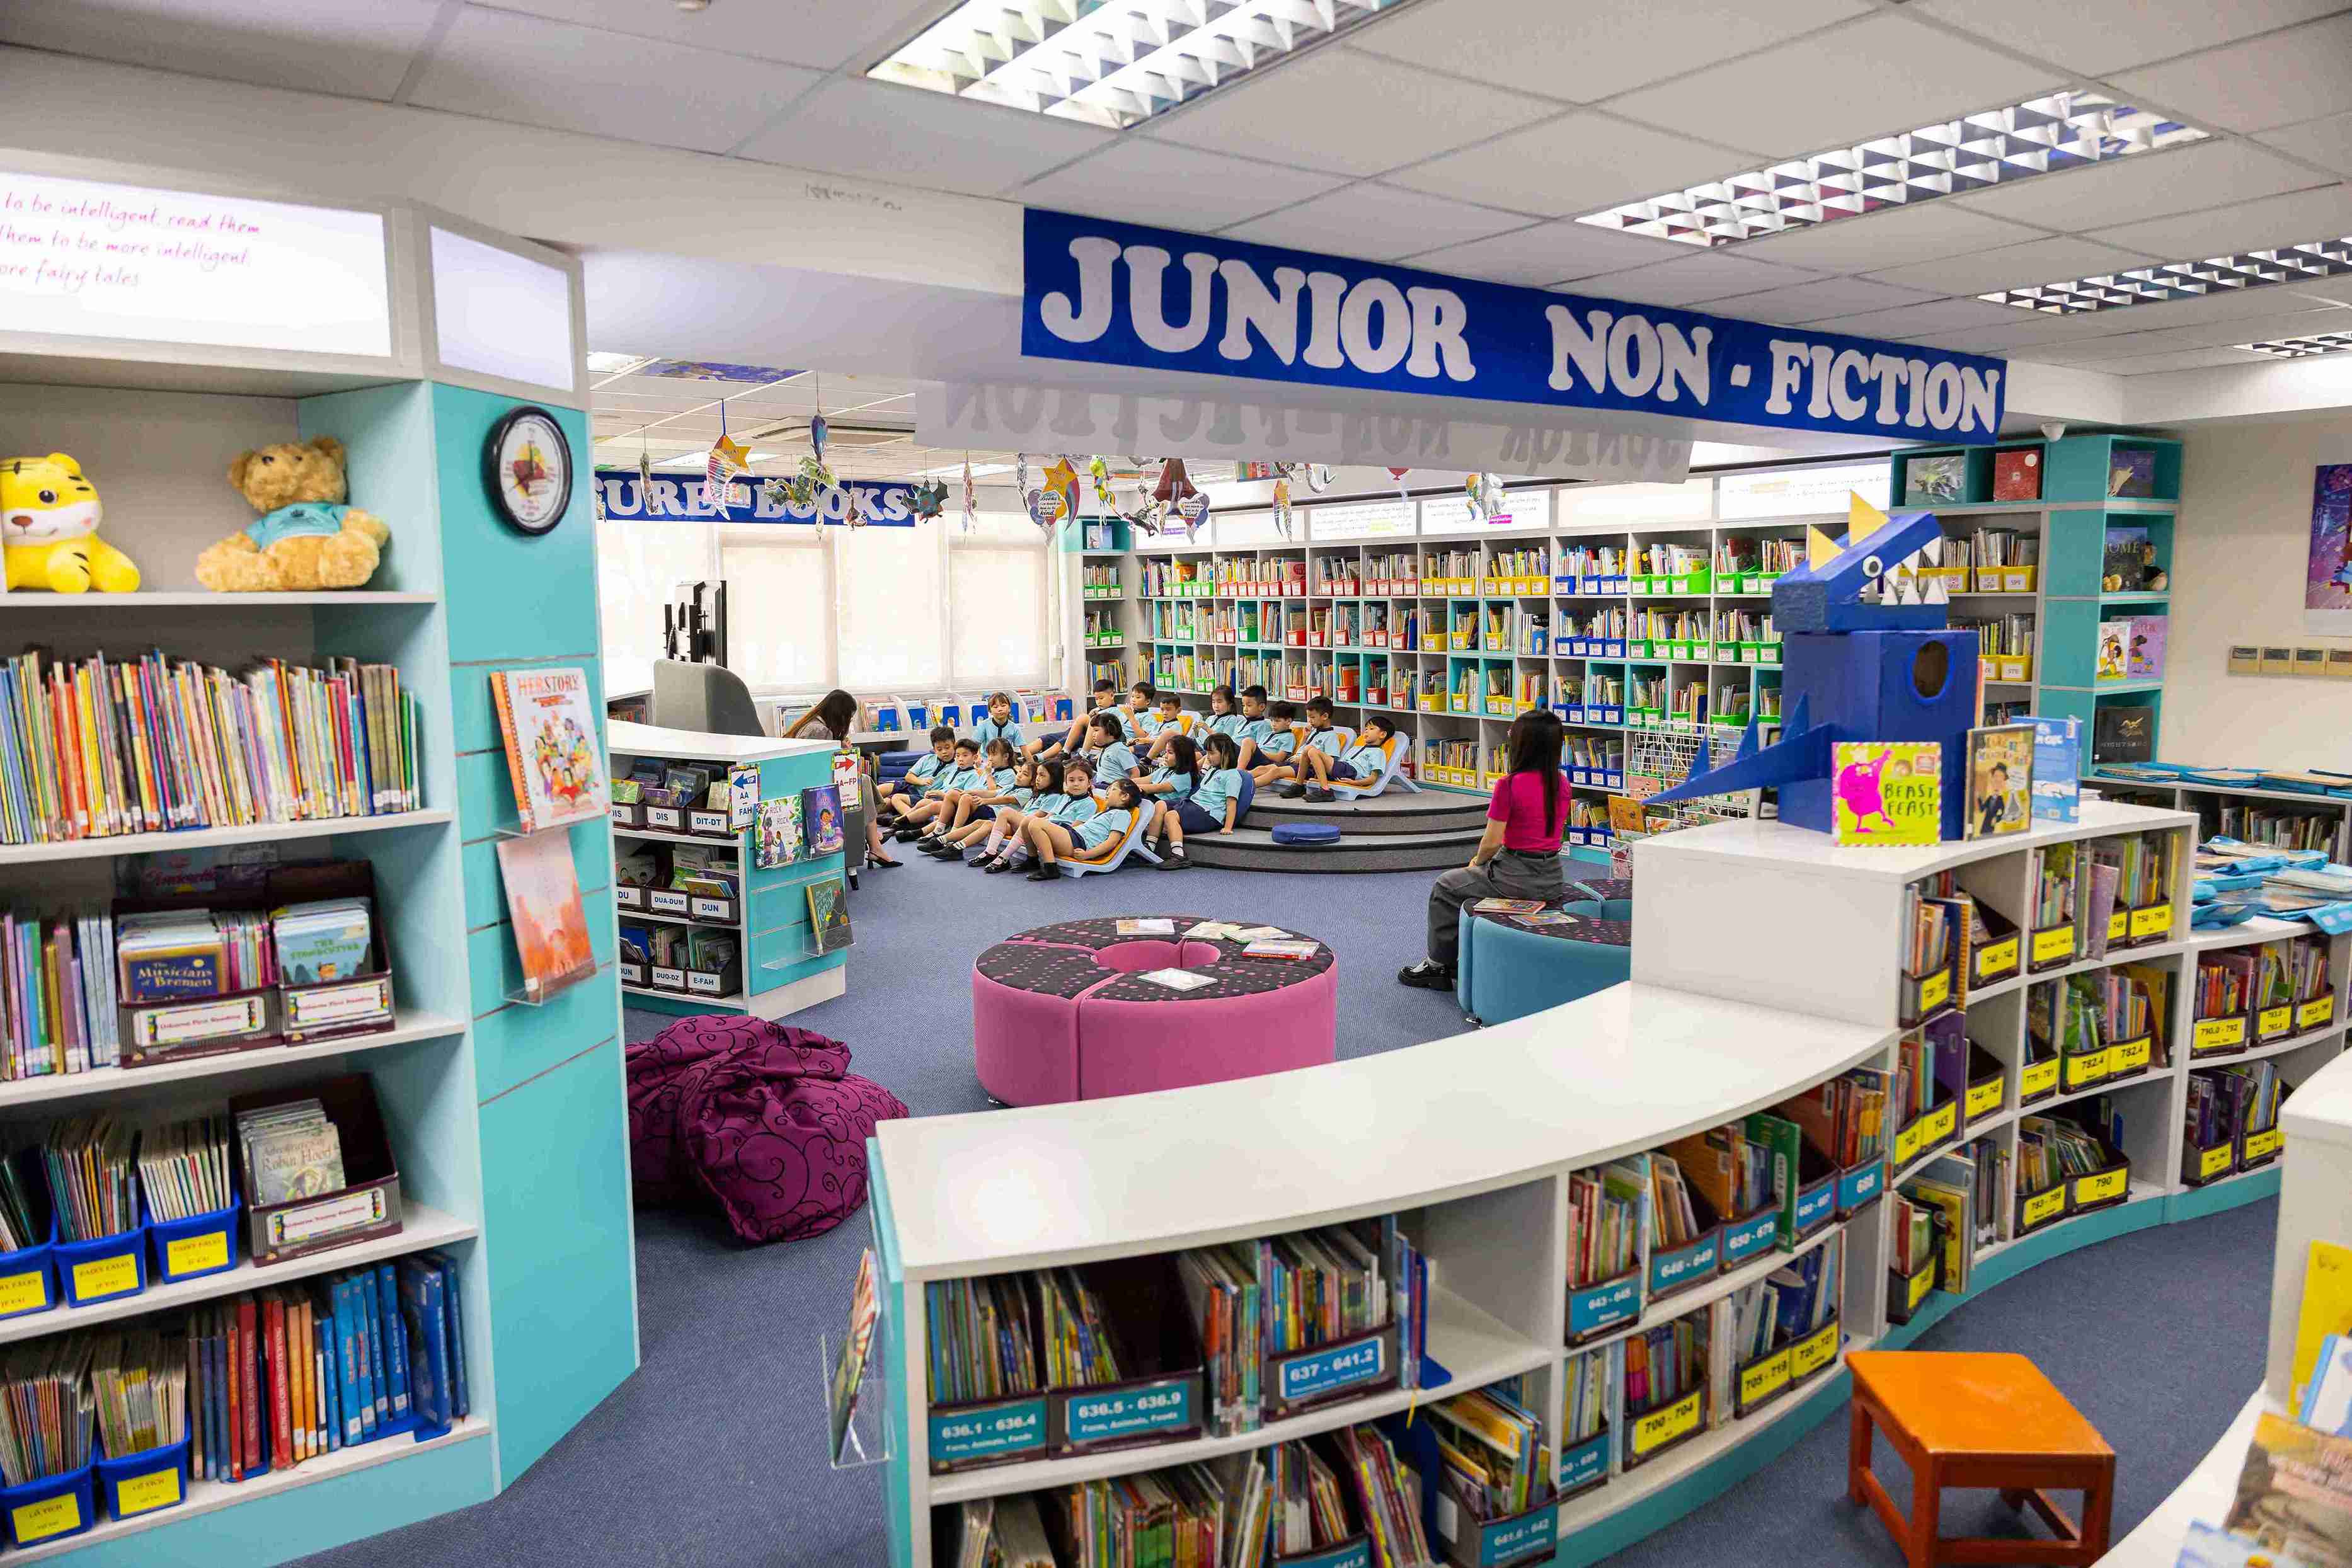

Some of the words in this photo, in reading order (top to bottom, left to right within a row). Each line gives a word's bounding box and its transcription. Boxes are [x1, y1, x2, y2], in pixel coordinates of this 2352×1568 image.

[5, 193, 23, 209] to
[32, 194, 52, 212] be
[169, 214, 211, 228] read
[221, 214, 260, 233] them
[52, 231, 69, 246] to
[78, 232, 98, 249] be
[106, 242, 150, 255] more
[0, 265, 28, 276] ore
[1040, 236, 1476, 382] JUNIOR
[1546, 305, 1712, 406] NON
[1765, 339, 2000, 433] FICTION
[595, 477, 718, 518] URE
[1884, 784, 1936, 799] BEAST
[656, 812, 669, 821] DIS
[739, 807, 752, 816] FAH
[1887, 802, 1936, 818] FEAST
[696, 817, 721, 827] DIT-DT
[655, 896, 684, 906] DUA-DUM
[702, 903, 719, 912] DUN
[138, 968, 212, 978] Musicians
[154, 977, 212, 988] Bremen
[693, 977, 714, 985] E-FAH
[2096, 1176, 2113, 1187] 790
[1290, 1363, 1319, 1381] 637
[1333, 1348, 1374, 1371] 641.2
[1137, 1392, 1181, 1410] 636.9
[942, 1423, 982, 1439] 636.1
[995, 1414, 1036, 1431] 636.4
